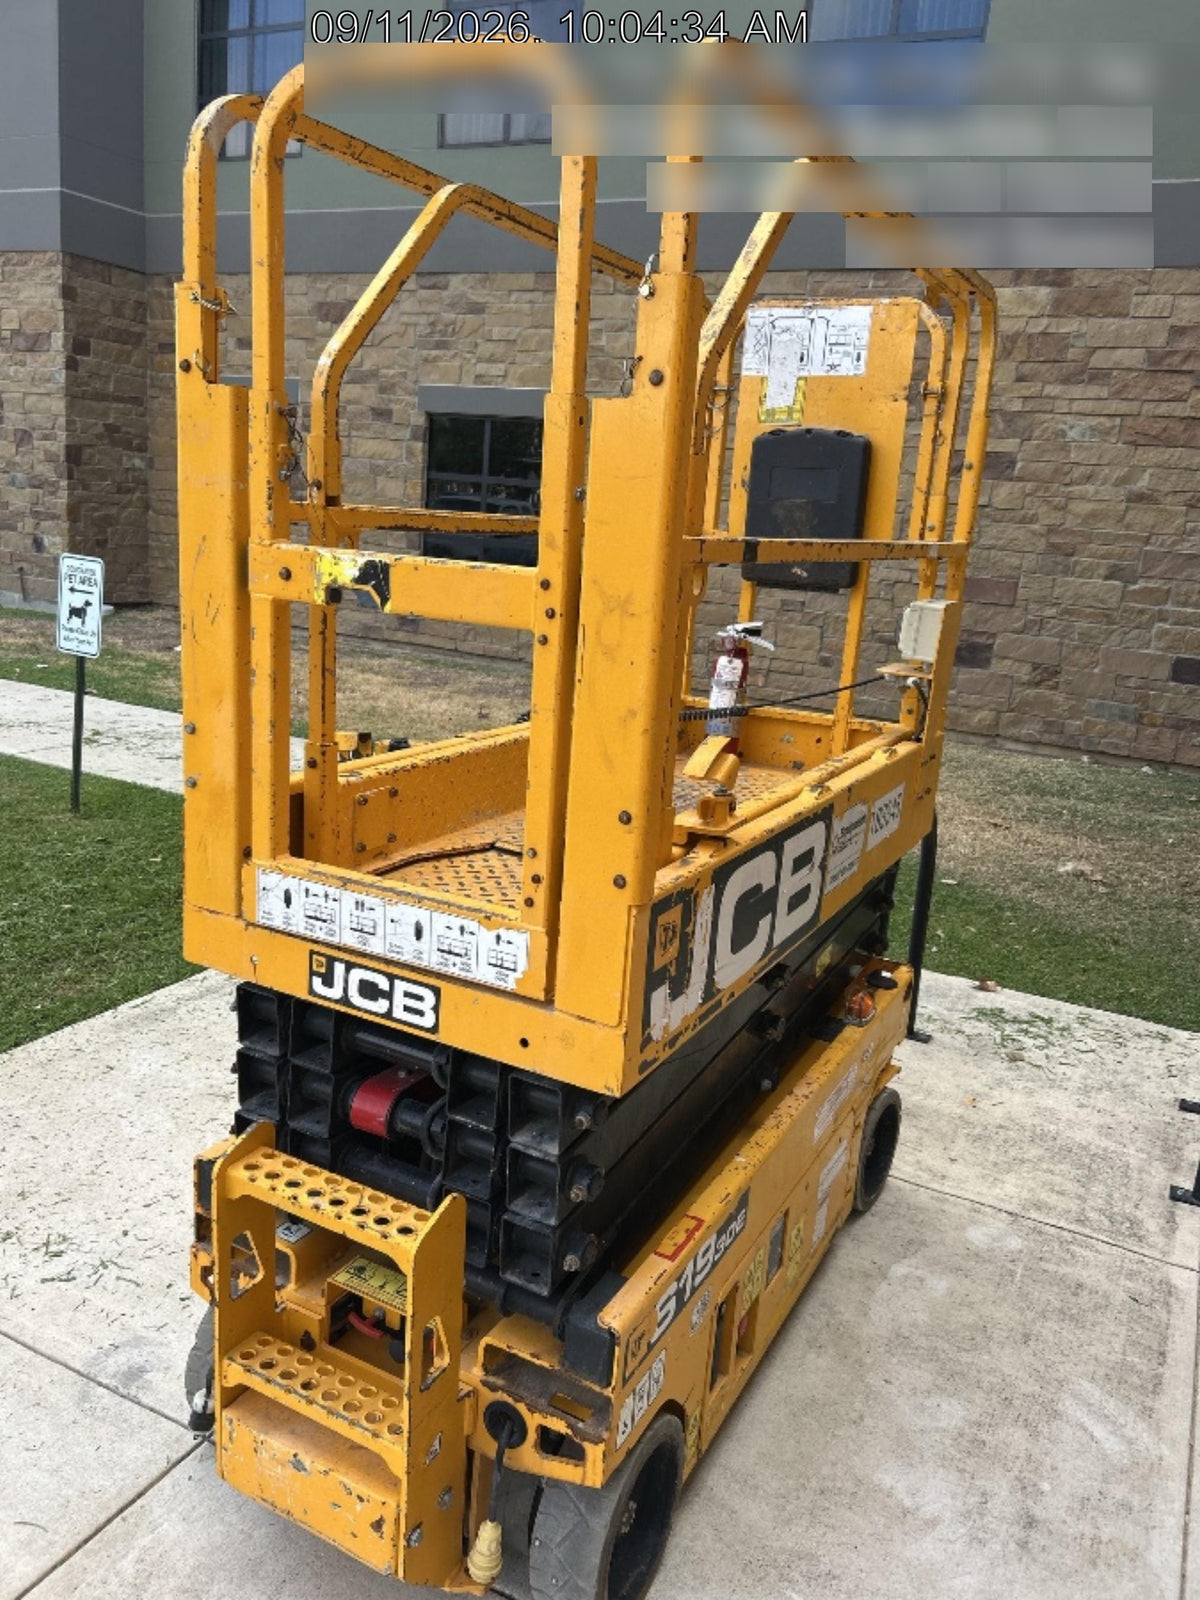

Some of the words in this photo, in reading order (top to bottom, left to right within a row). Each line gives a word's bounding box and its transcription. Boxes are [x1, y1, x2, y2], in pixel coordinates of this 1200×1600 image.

[79, 575, 98, 588] AREA
[650, 820, 827, 1041] JCB
[312, 961, 437, 1029] JCB
